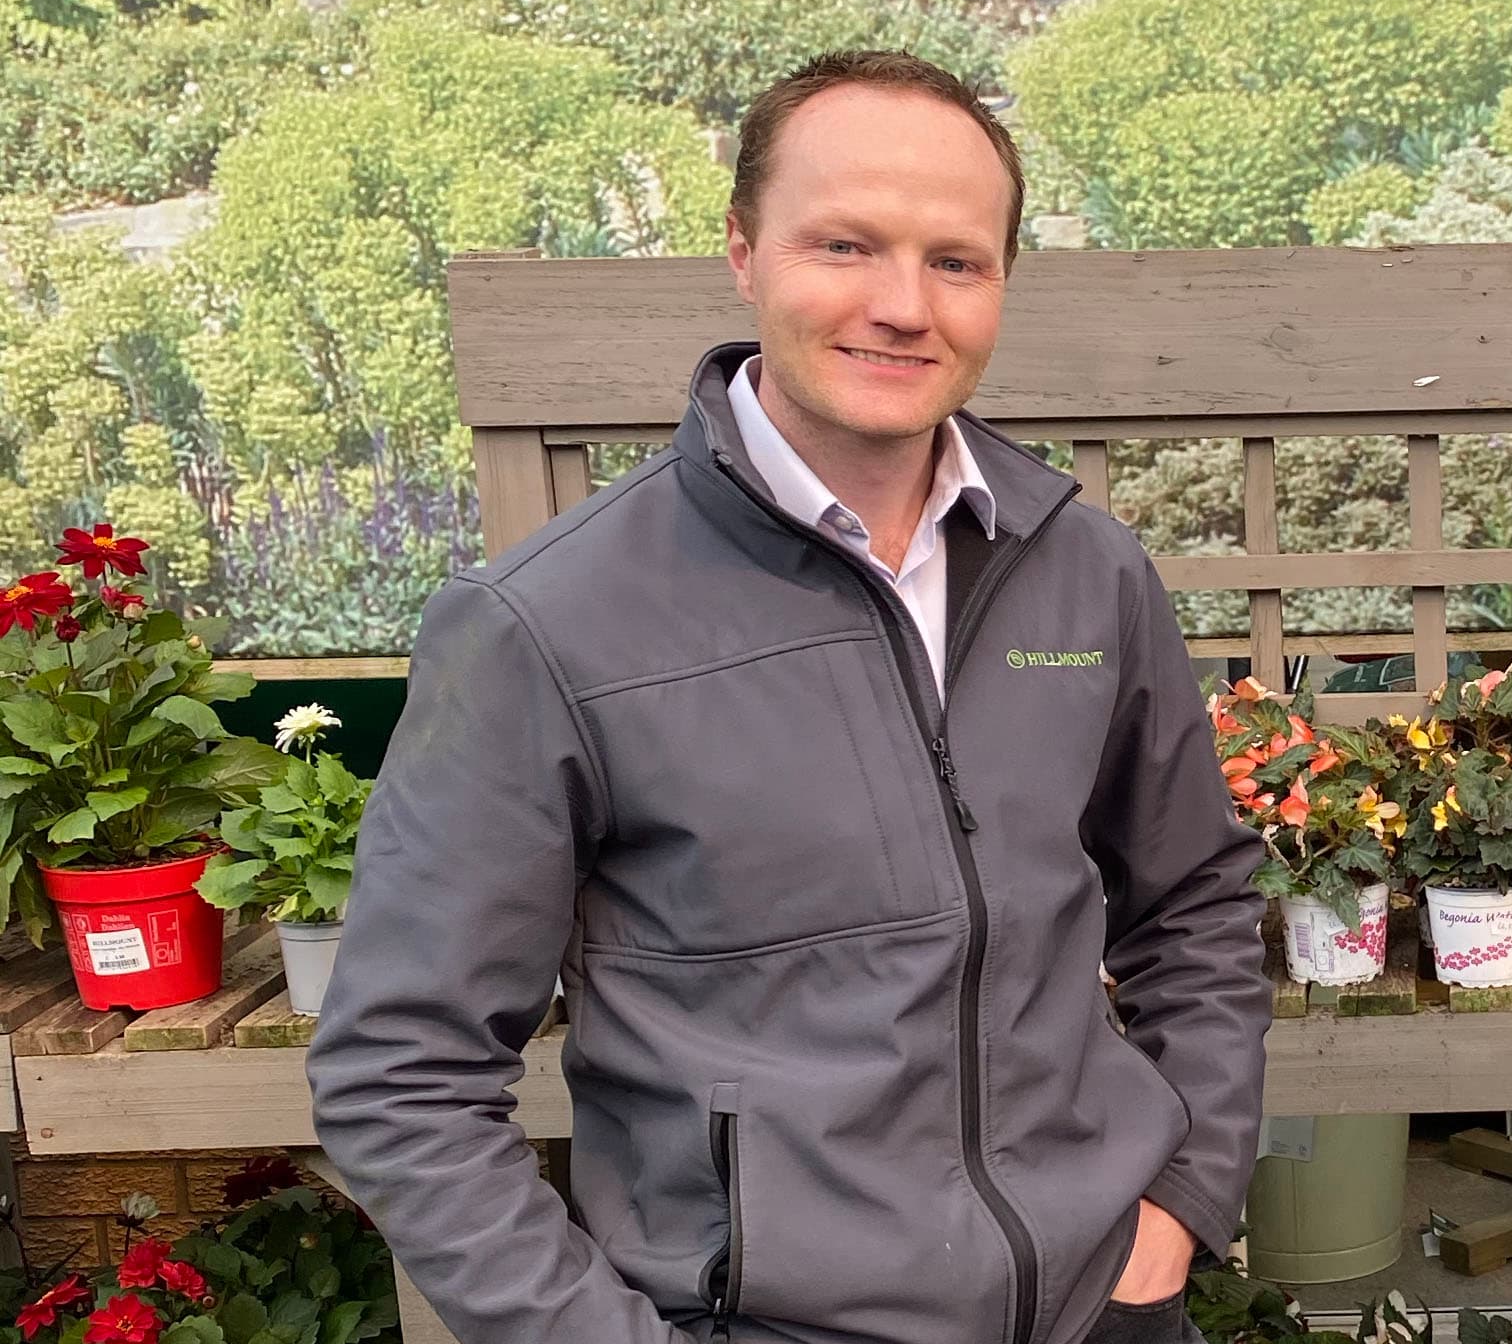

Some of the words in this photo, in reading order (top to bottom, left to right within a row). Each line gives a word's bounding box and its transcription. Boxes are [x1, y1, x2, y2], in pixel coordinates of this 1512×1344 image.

[1026, 651, 1104, 666] HILLMOUNT
[101, 914, 131, 923] Dahlia
[1439, 909, 1482, 927] Begonia
